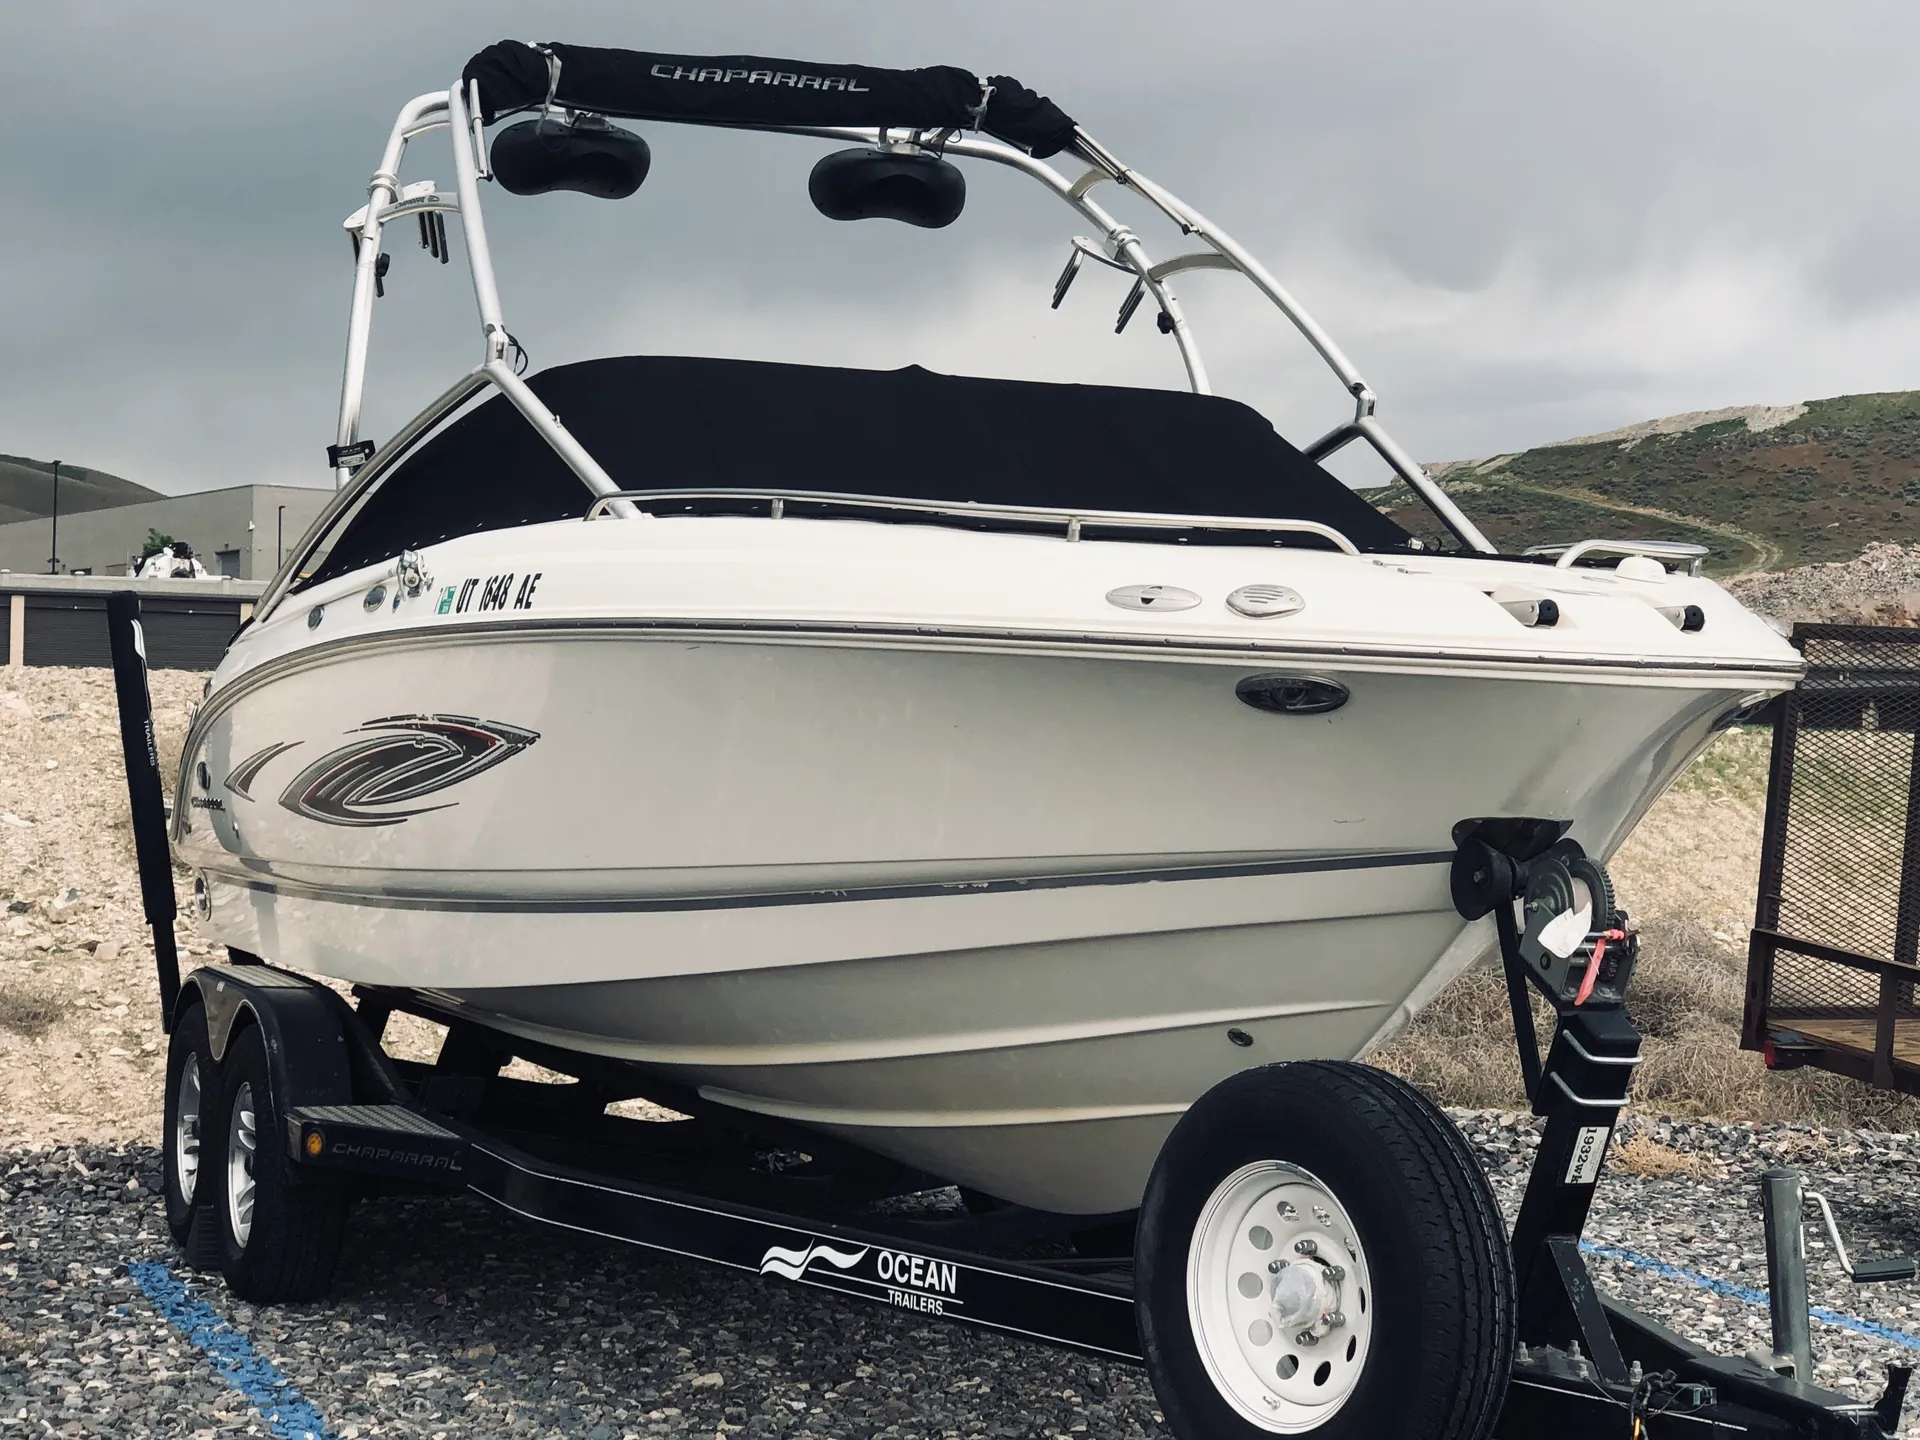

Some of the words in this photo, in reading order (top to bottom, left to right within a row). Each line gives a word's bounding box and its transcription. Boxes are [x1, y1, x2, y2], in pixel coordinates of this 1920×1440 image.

[650, 63, 870, 92] CHAPARRAL
[456, 578, 480, 614] UT
[478, 573, 514, 612] 1648
[513, 573, 542, 609] AE
[332, 1143, 462, 1171] CHAPARRAL
[877, 1250, 957, 1294] OCEAN
[887, 1289, 943, 1316] TRAILERS
